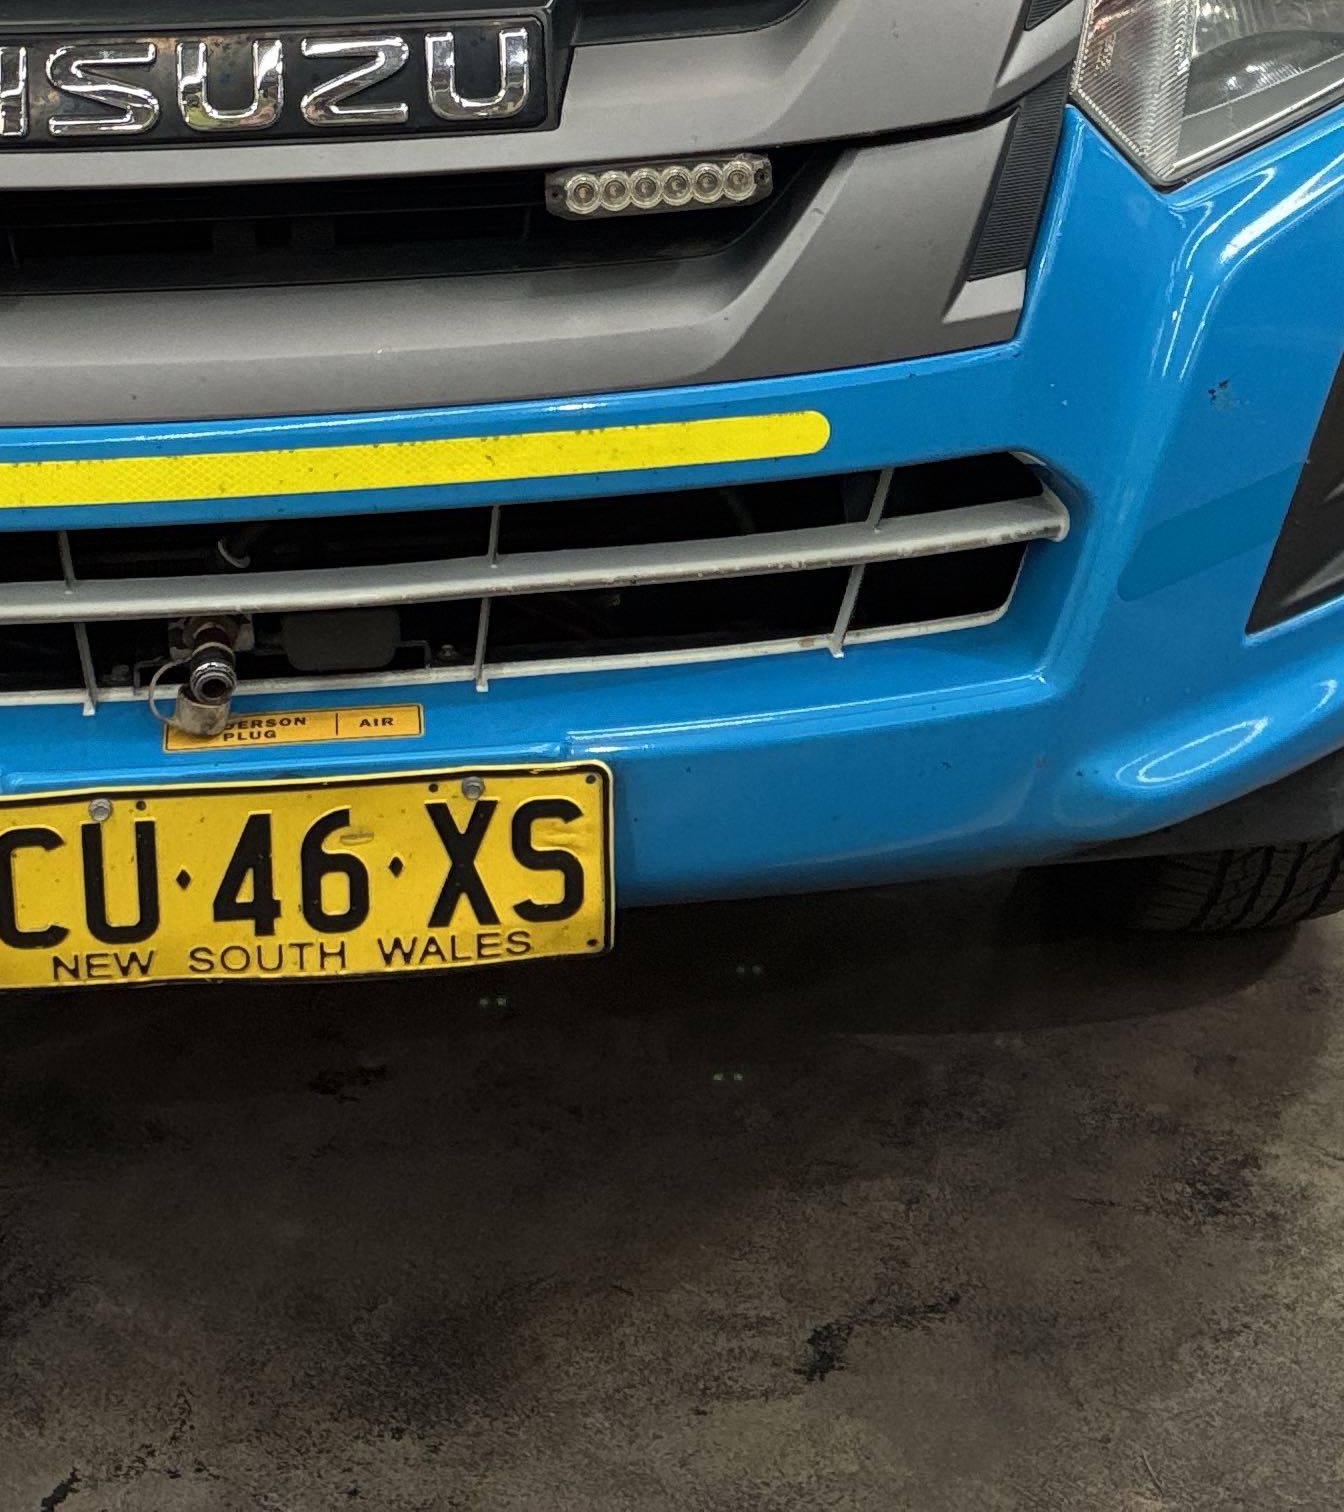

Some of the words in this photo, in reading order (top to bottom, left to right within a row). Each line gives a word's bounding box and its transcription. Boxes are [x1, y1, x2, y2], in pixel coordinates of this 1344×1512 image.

[359, 717, 394, 728] AIR
[223, 730, 277, 742] PLUG
[51, 948, 156, 982] NEW
[188, 938, 348, 974] SOUTH
[378, 928, 534, 966] WALES
